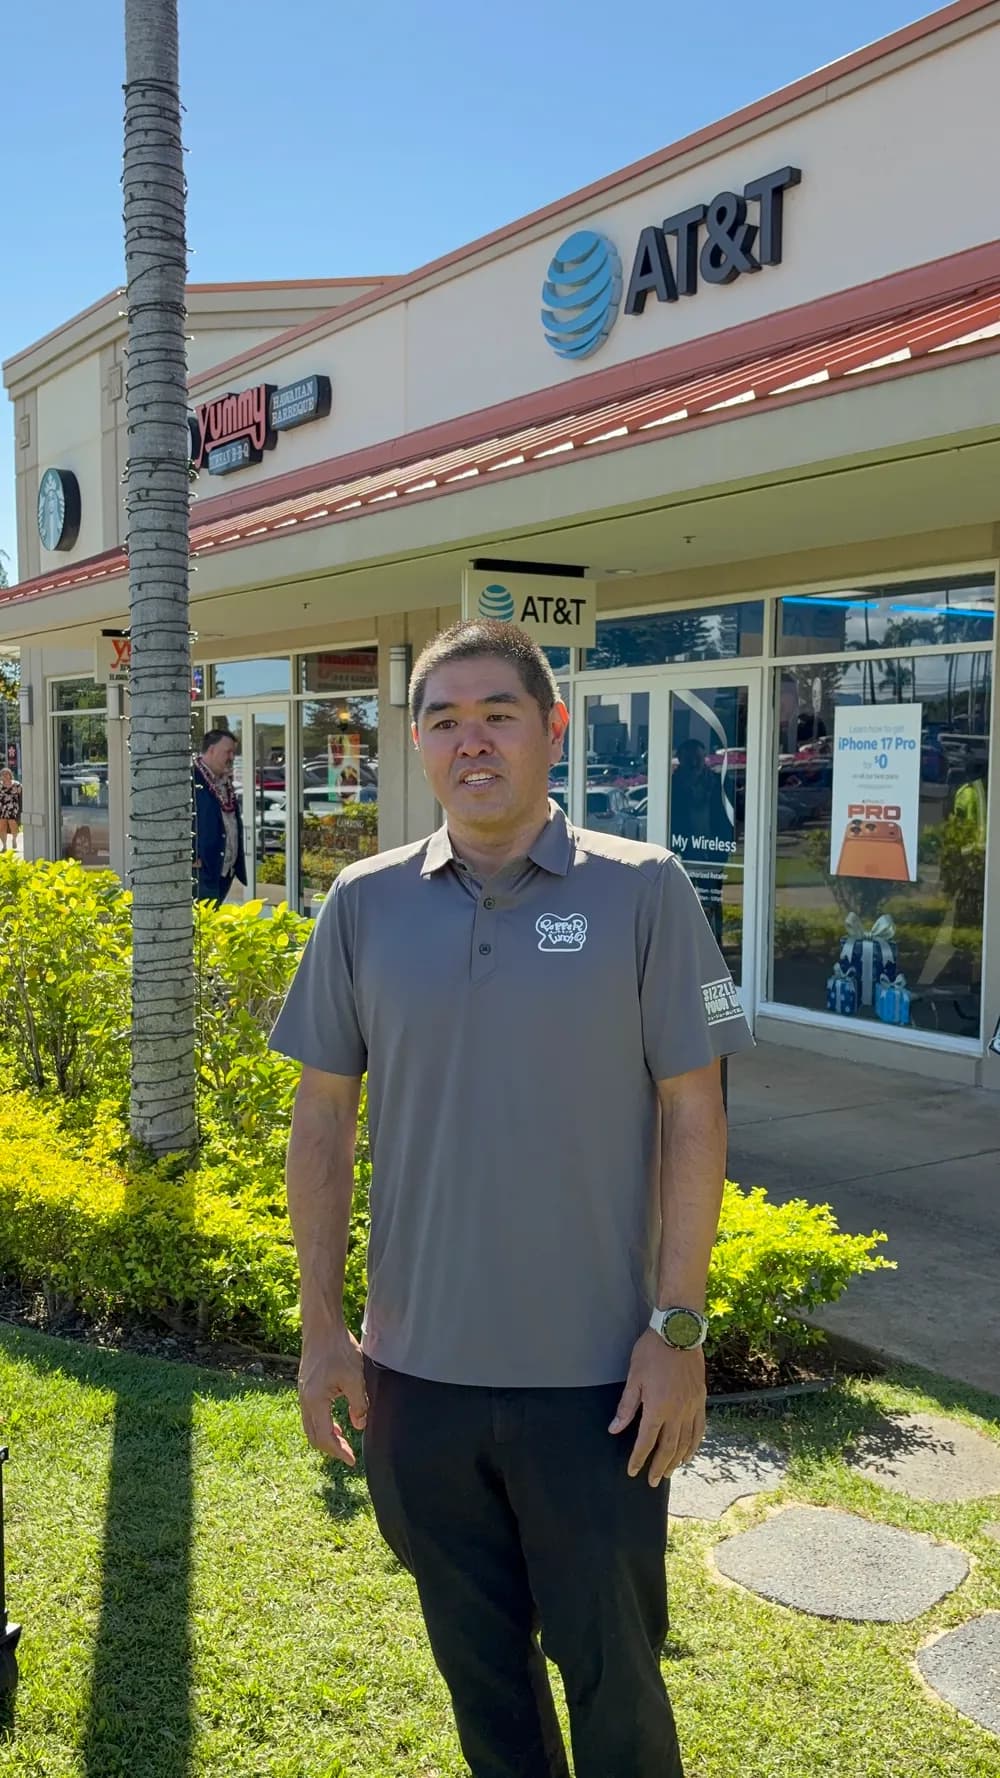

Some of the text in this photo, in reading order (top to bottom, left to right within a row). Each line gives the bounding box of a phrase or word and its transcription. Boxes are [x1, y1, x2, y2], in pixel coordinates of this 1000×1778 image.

[624, 166, 801, 316] AT&T
[272, 381, 314, 410] HAWAIIAN
[271, 396, 315, 425] BARBEQUE
[520, 596, 586, 625] AT&T
[838, 736, 916, 750] iPhone 17 Pro
[874, 753, 888, 769] $0
[847, 804, 902, 820] PRO
[672, 834, 737, 853] My Wireless
[705, 998, 730, 1015] YOUR
